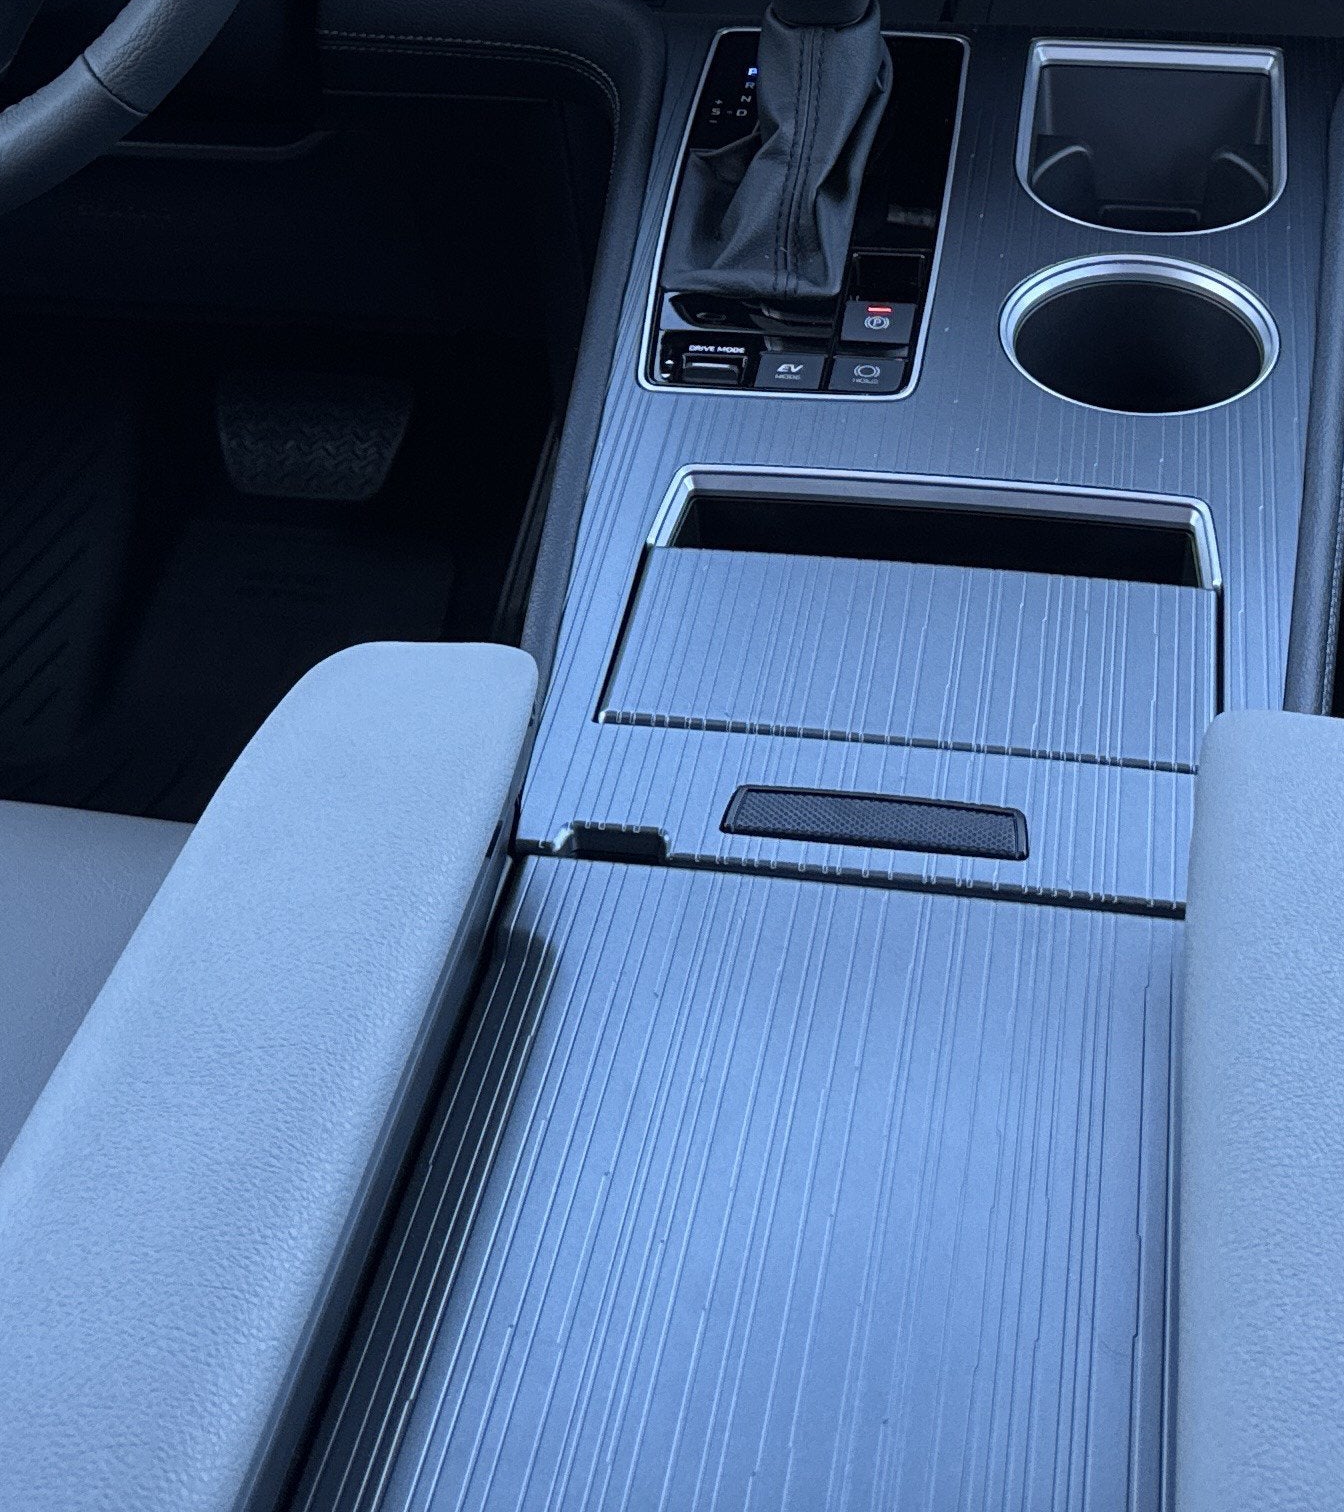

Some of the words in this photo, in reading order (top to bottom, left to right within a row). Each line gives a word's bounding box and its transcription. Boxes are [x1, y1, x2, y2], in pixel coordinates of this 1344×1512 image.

[745, 81, 755, 89] R
[689, 344, 716, 352] DRIVE
[717, 346, 745, 354] MODE
[776, 363, 804, 373] EV
